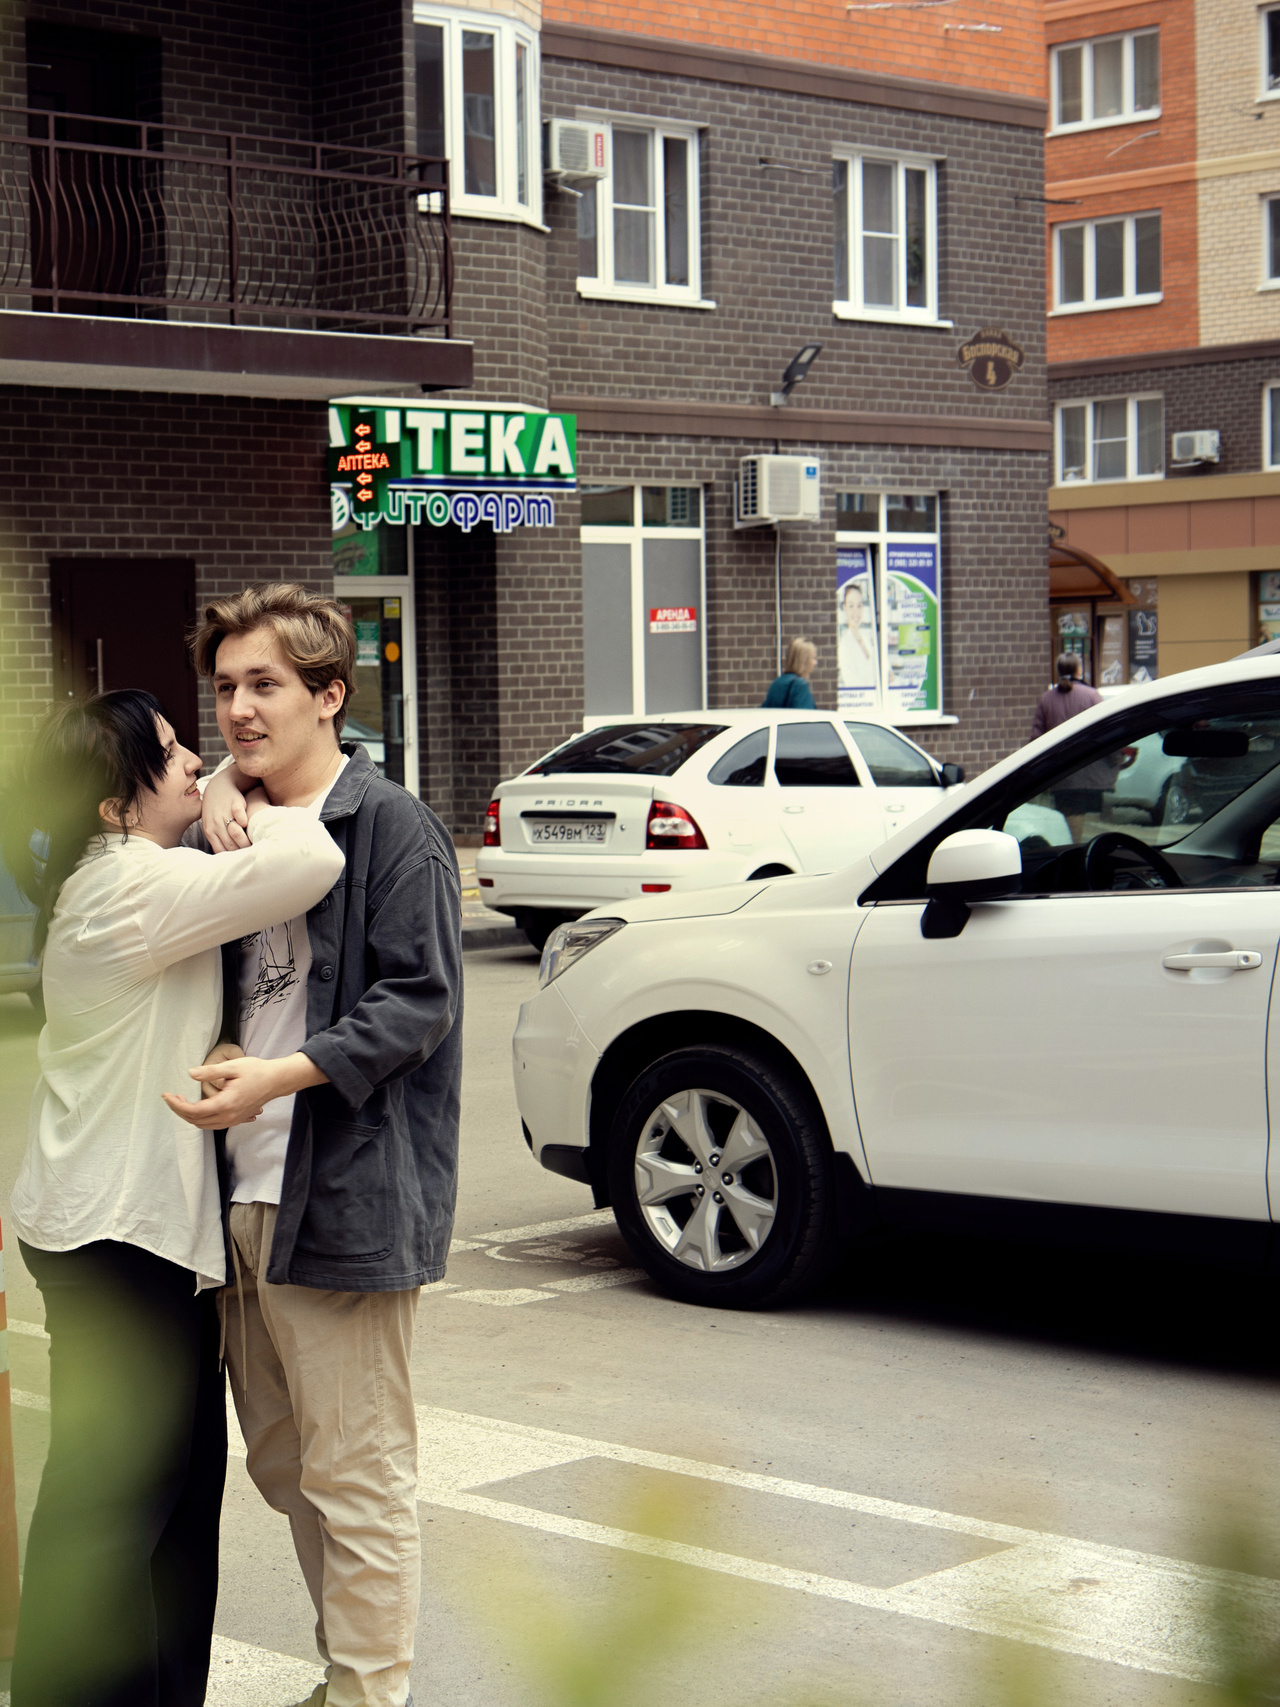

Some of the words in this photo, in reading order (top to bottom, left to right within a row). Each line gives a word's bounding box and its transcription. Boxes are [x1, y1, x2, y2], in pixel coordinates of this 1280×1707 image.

[337, 452, 390, 471] АПТЕКА
[656, 608, 690, 621] АРЕНДА
[584, 824, 603, 836] 123
